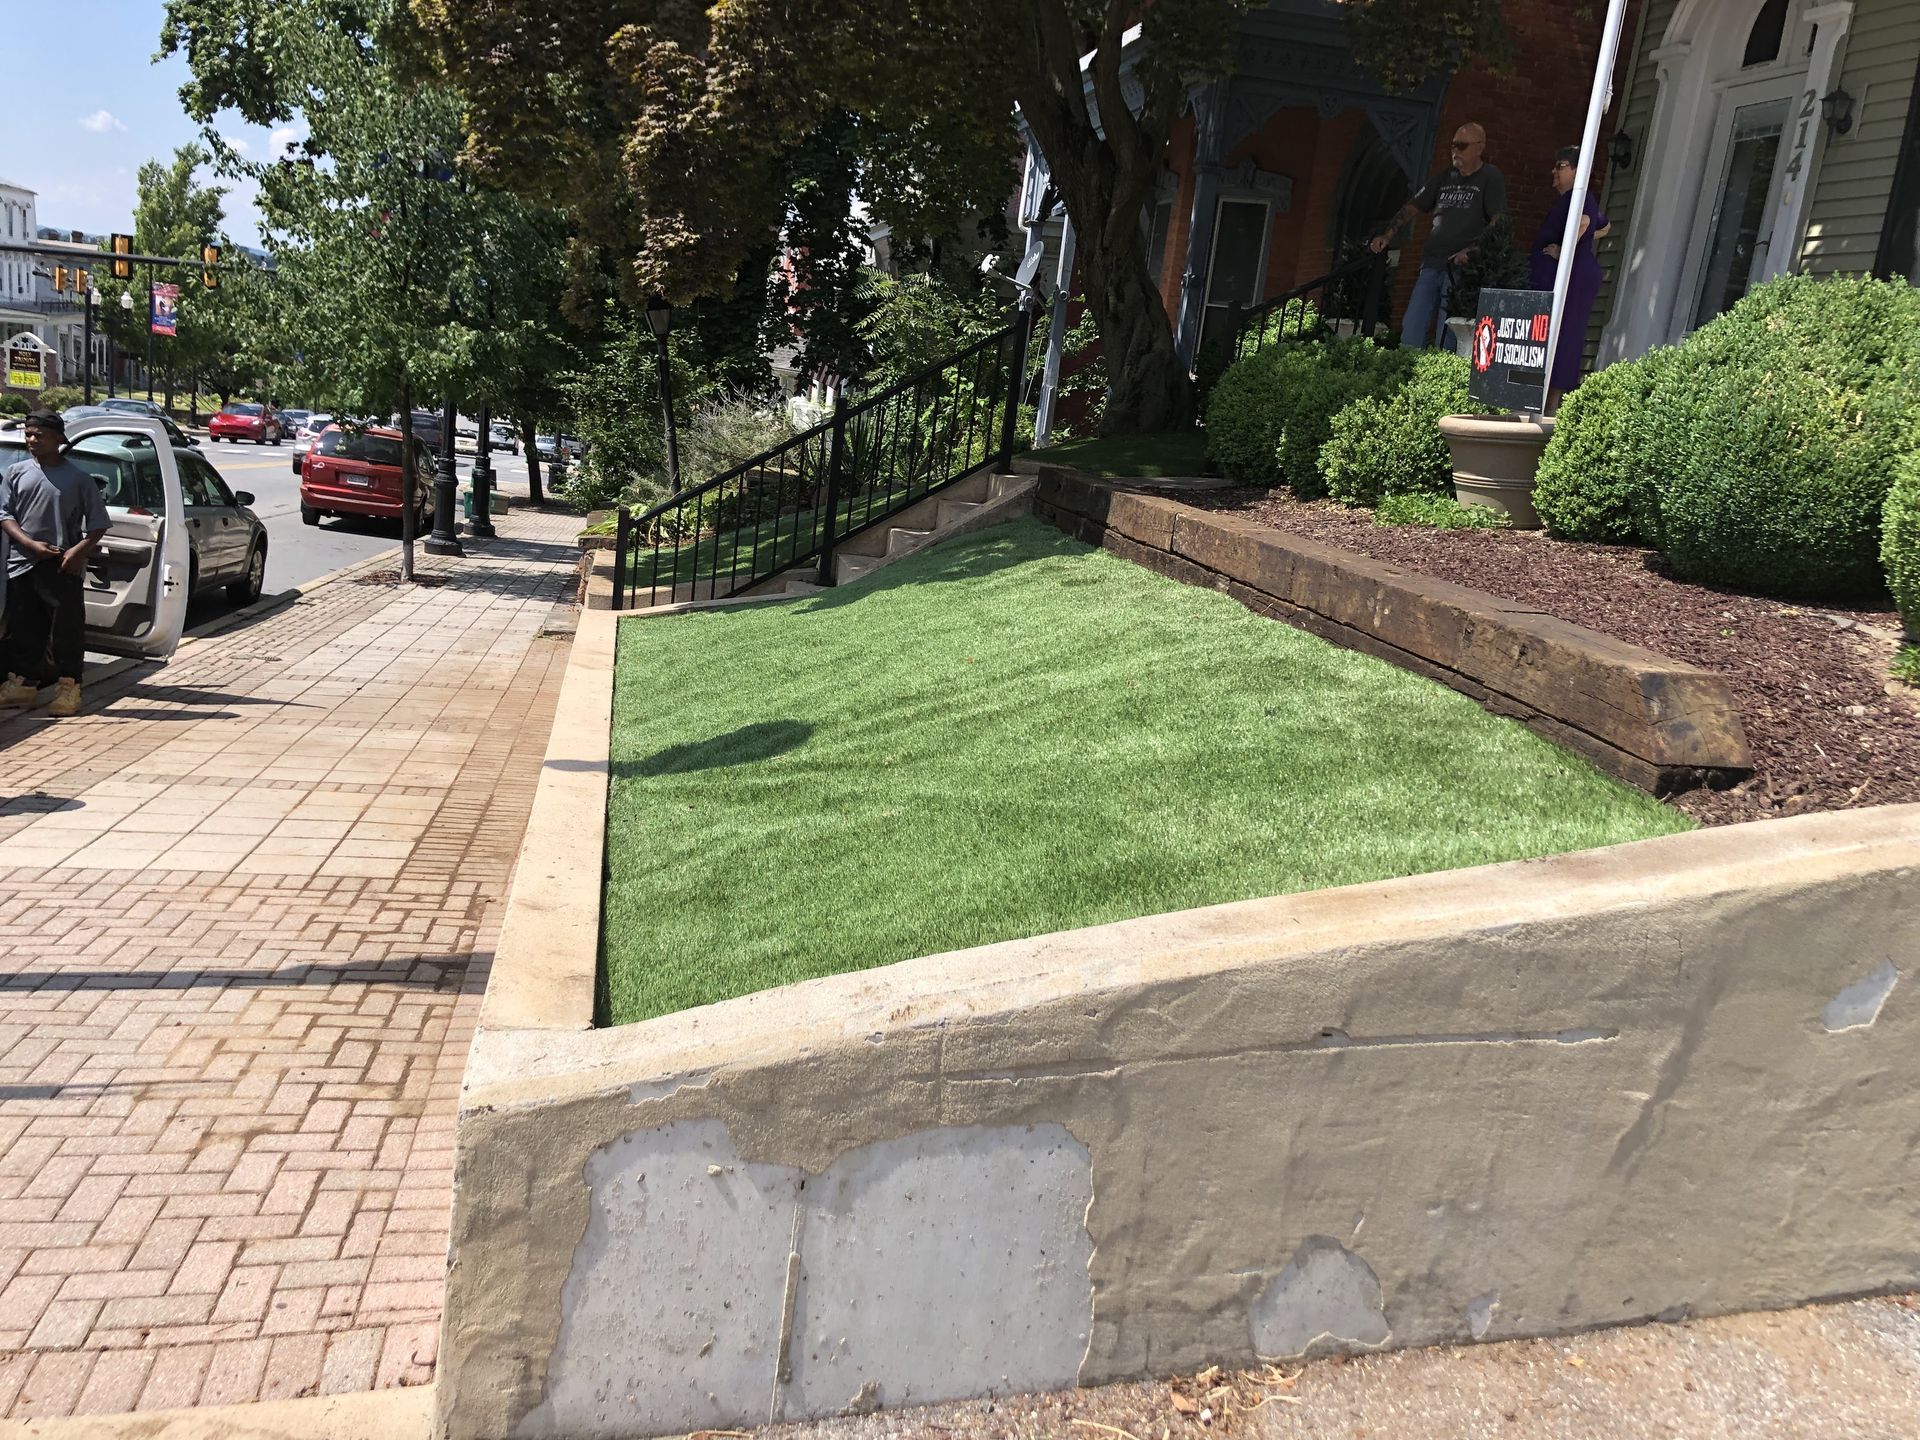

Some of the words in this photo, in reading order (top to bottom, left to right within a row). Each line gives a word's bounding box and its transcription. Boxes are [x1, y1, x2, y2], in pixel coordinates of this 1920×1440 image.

[1785, 88, 1817, 182] 214
[1497, 317, 1516, 338] JUST
[1515, 319, 1532, 341] SAY
[1531, 314, 1549, 342] NO
[1494, 342, 1504, 363] TO
[1503, 344, 1546, 369] SOCIALISM
